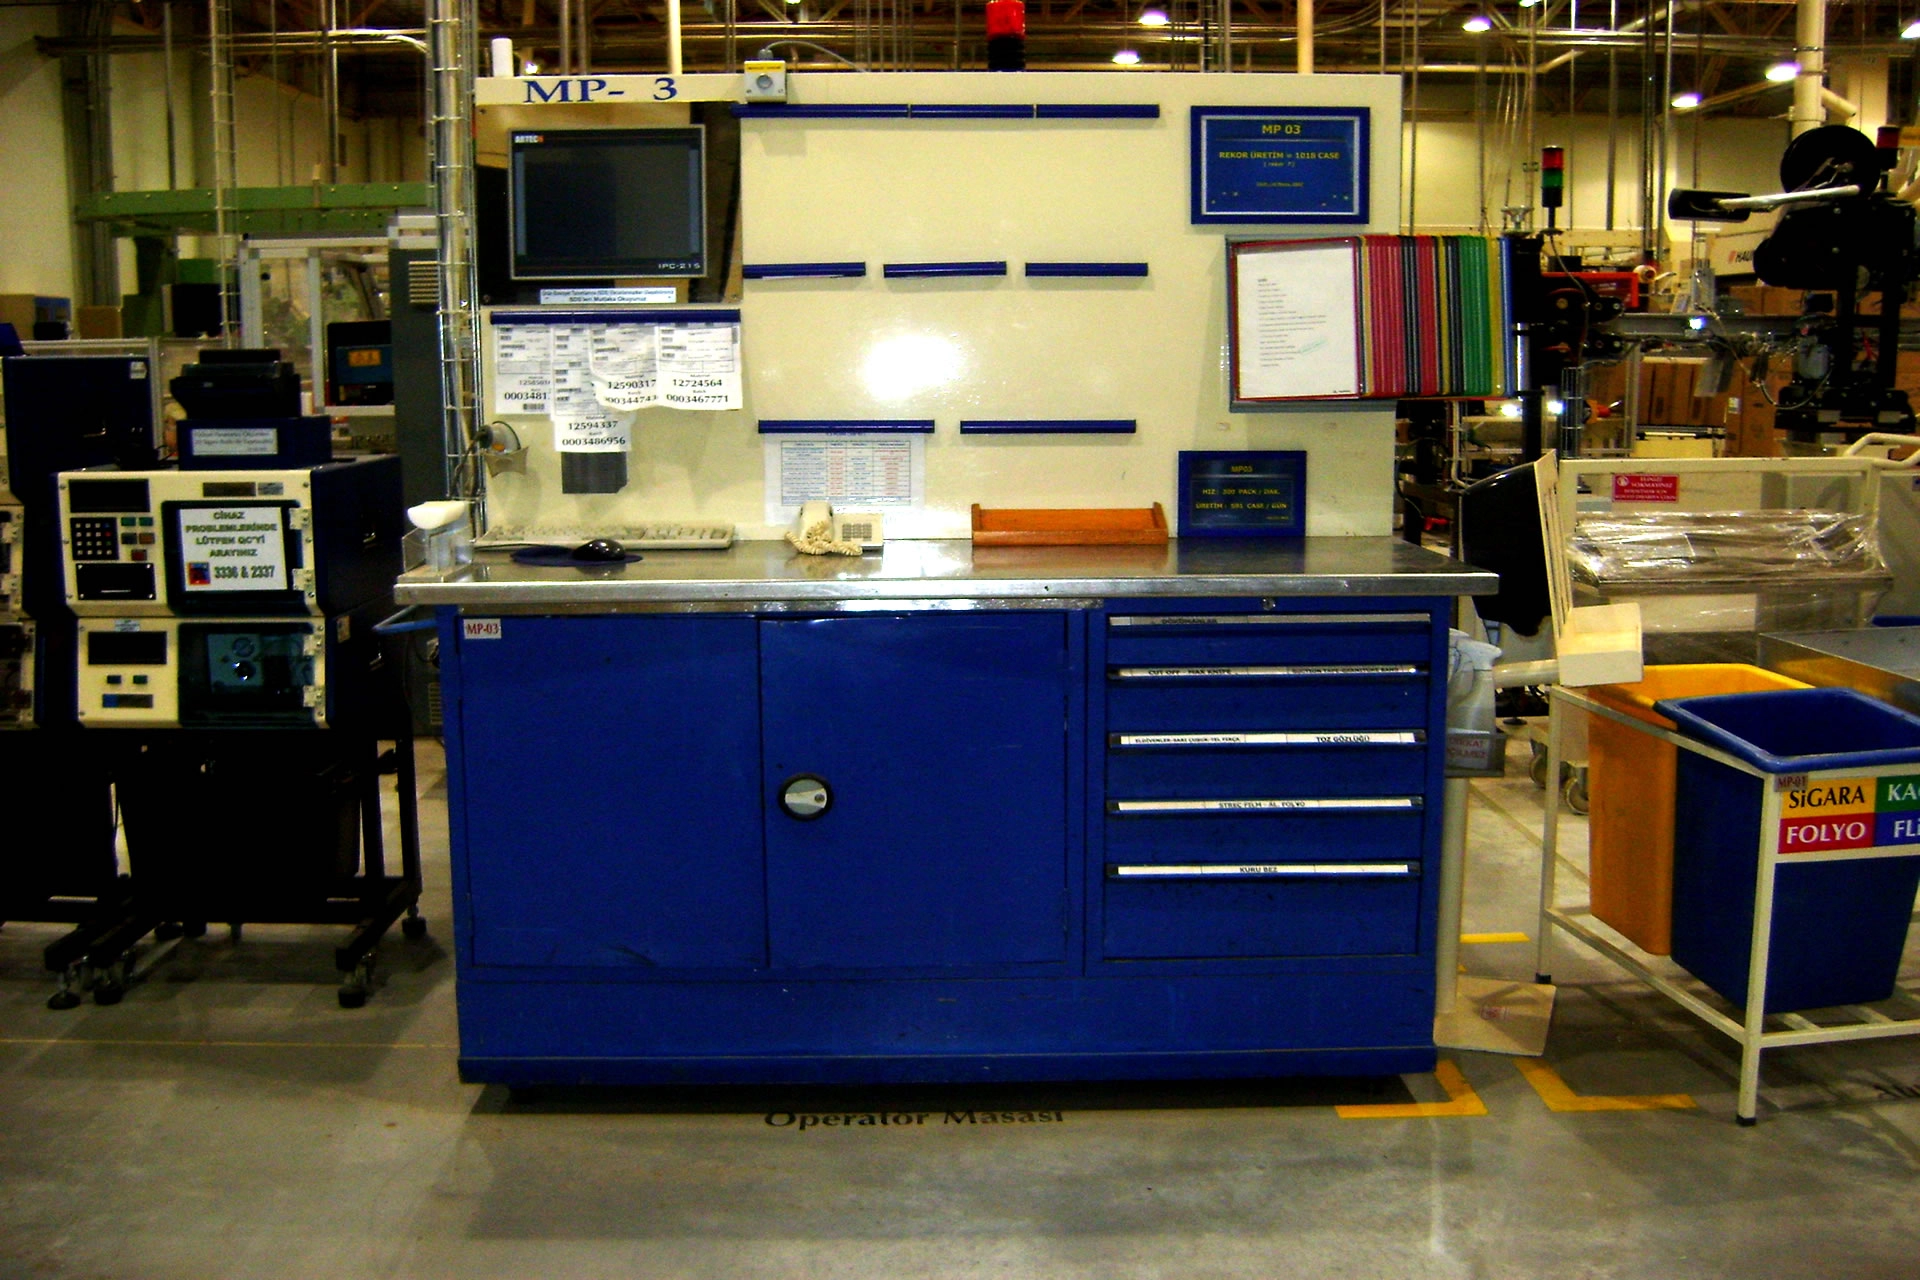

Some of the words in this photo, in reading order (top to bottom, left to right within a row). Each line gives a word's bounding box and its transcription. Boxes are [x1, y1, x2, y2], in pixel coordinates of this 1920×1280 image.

[522, 78, 625, 103] MP-
[653, 77, 678, 101] 3
[1261, 124, 1281, 134] MP
[1284, 124, 1301, 135] 03
[1218, 151, 1248, 159] REKOR
[1317, 152, 1340, 160] CASE
[673, 378, 723, 388] 12724564
[666, 393, 729, 403] 0003467771
[568, 420, 619, 431] 12594337
[562, 436, 626, 446] 0003486956
[1246, 502, 1265, 510] CASE
[196, 535, 235, 545] LÜTFEN
[241, 566, 249, 578] &
[251, 565, 276, 579] 2337
[467, 623, 499, 635] MP-03
[1315, 735, 1331, 743] TOZ
[1786, 821, 1866, 844] FOLYO
[764, 1109, 930, 1130] Operator
